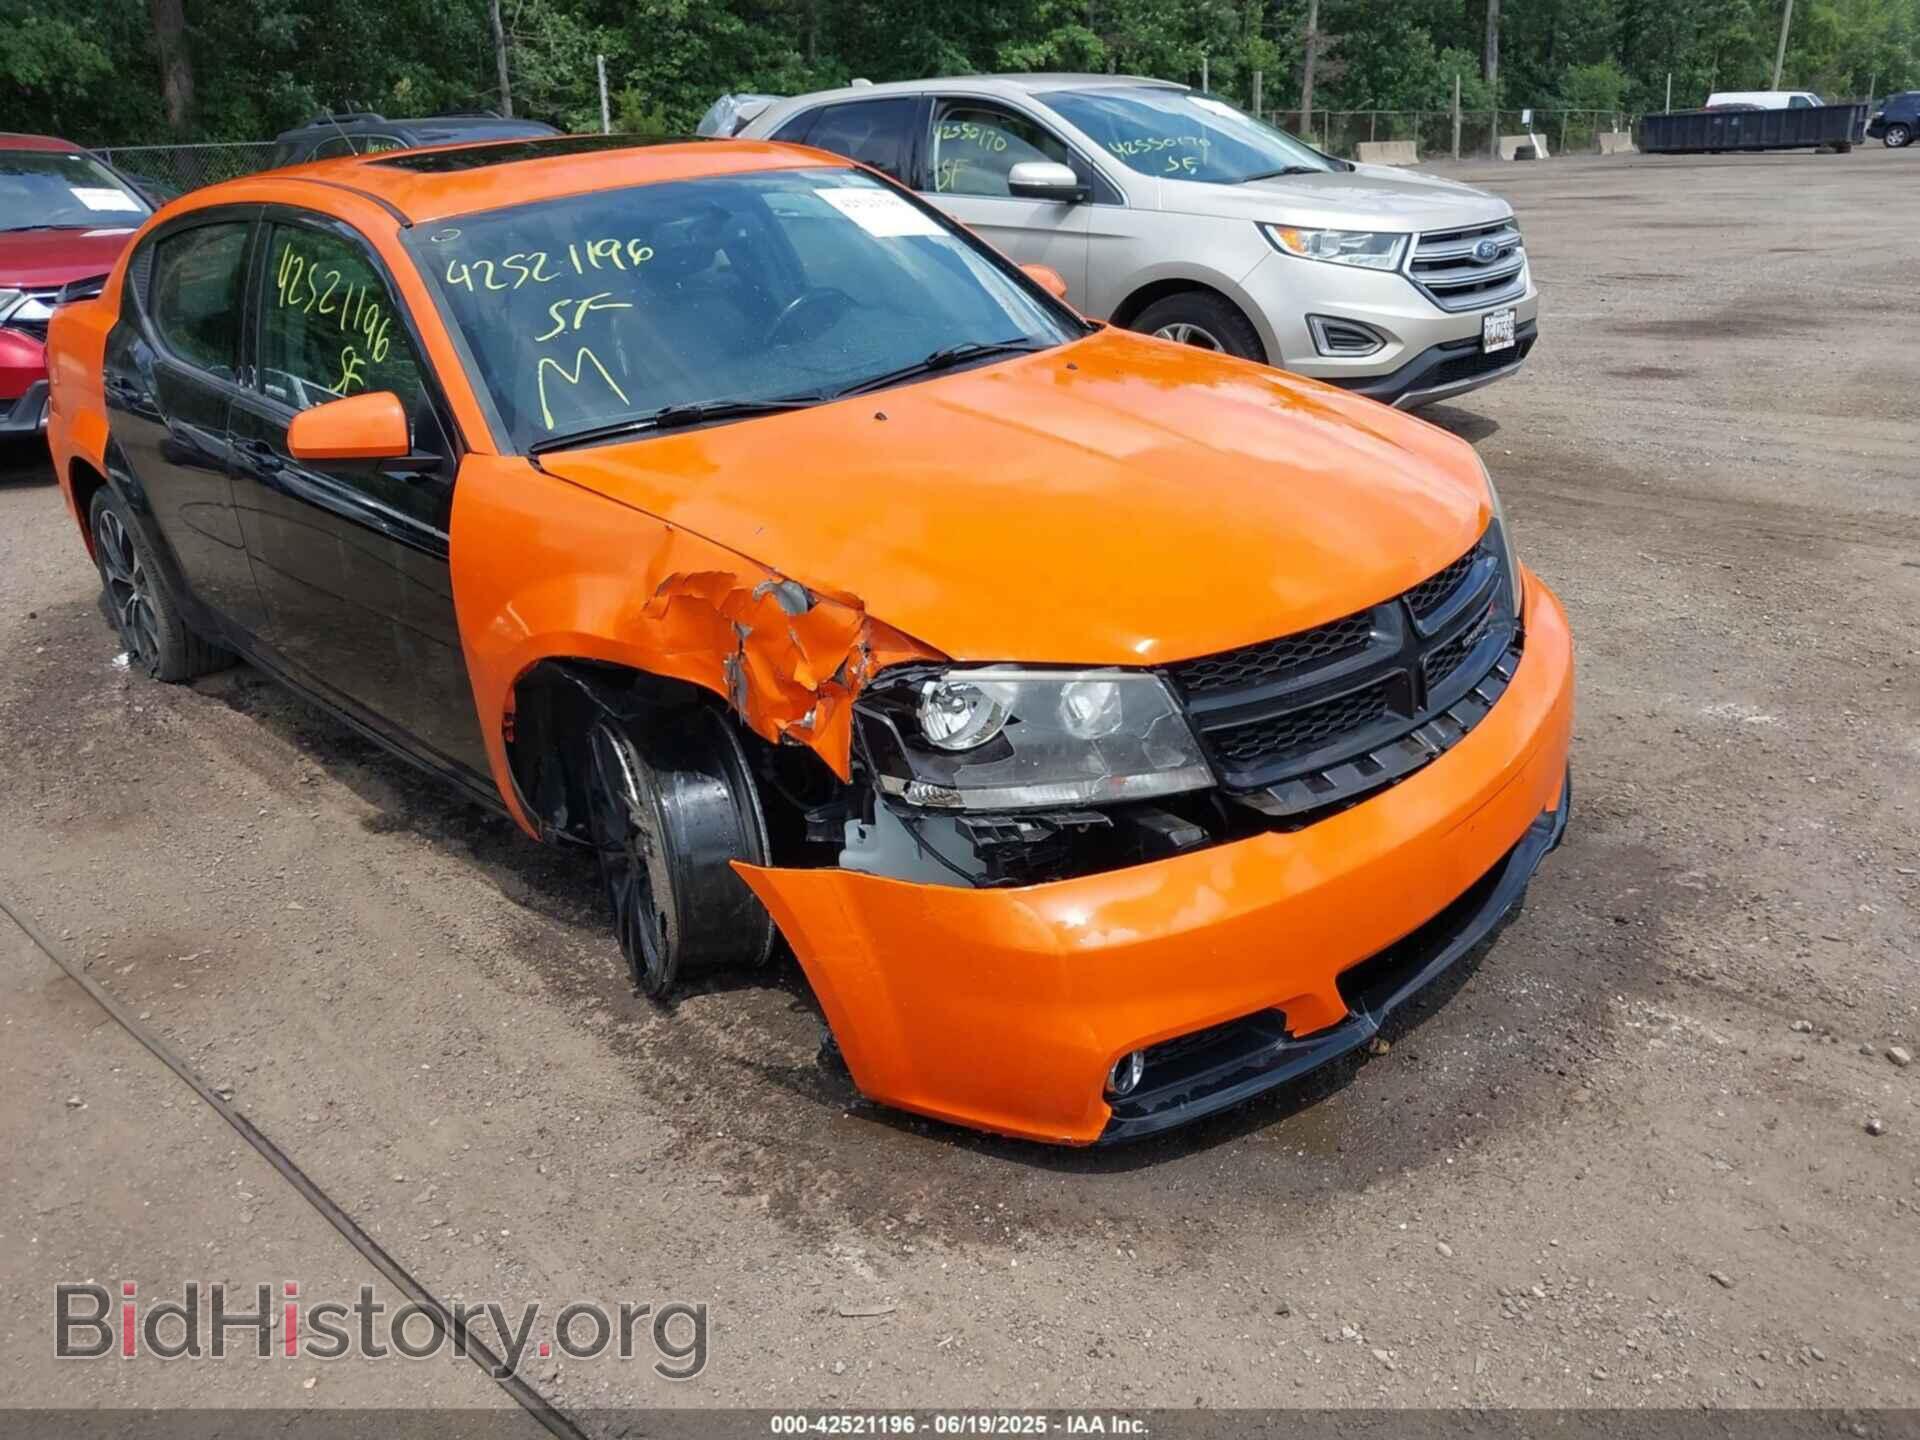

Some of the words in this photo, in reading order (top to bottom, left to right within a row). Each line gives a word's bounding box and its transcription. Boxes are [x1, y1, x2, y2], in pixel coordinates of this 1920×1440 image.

[446, 238, 654, 292] 42521196
[277, 242, 392, 363] 42521196
[534, 291, 633, 341] SF
[537, 347, 631, 431] M
